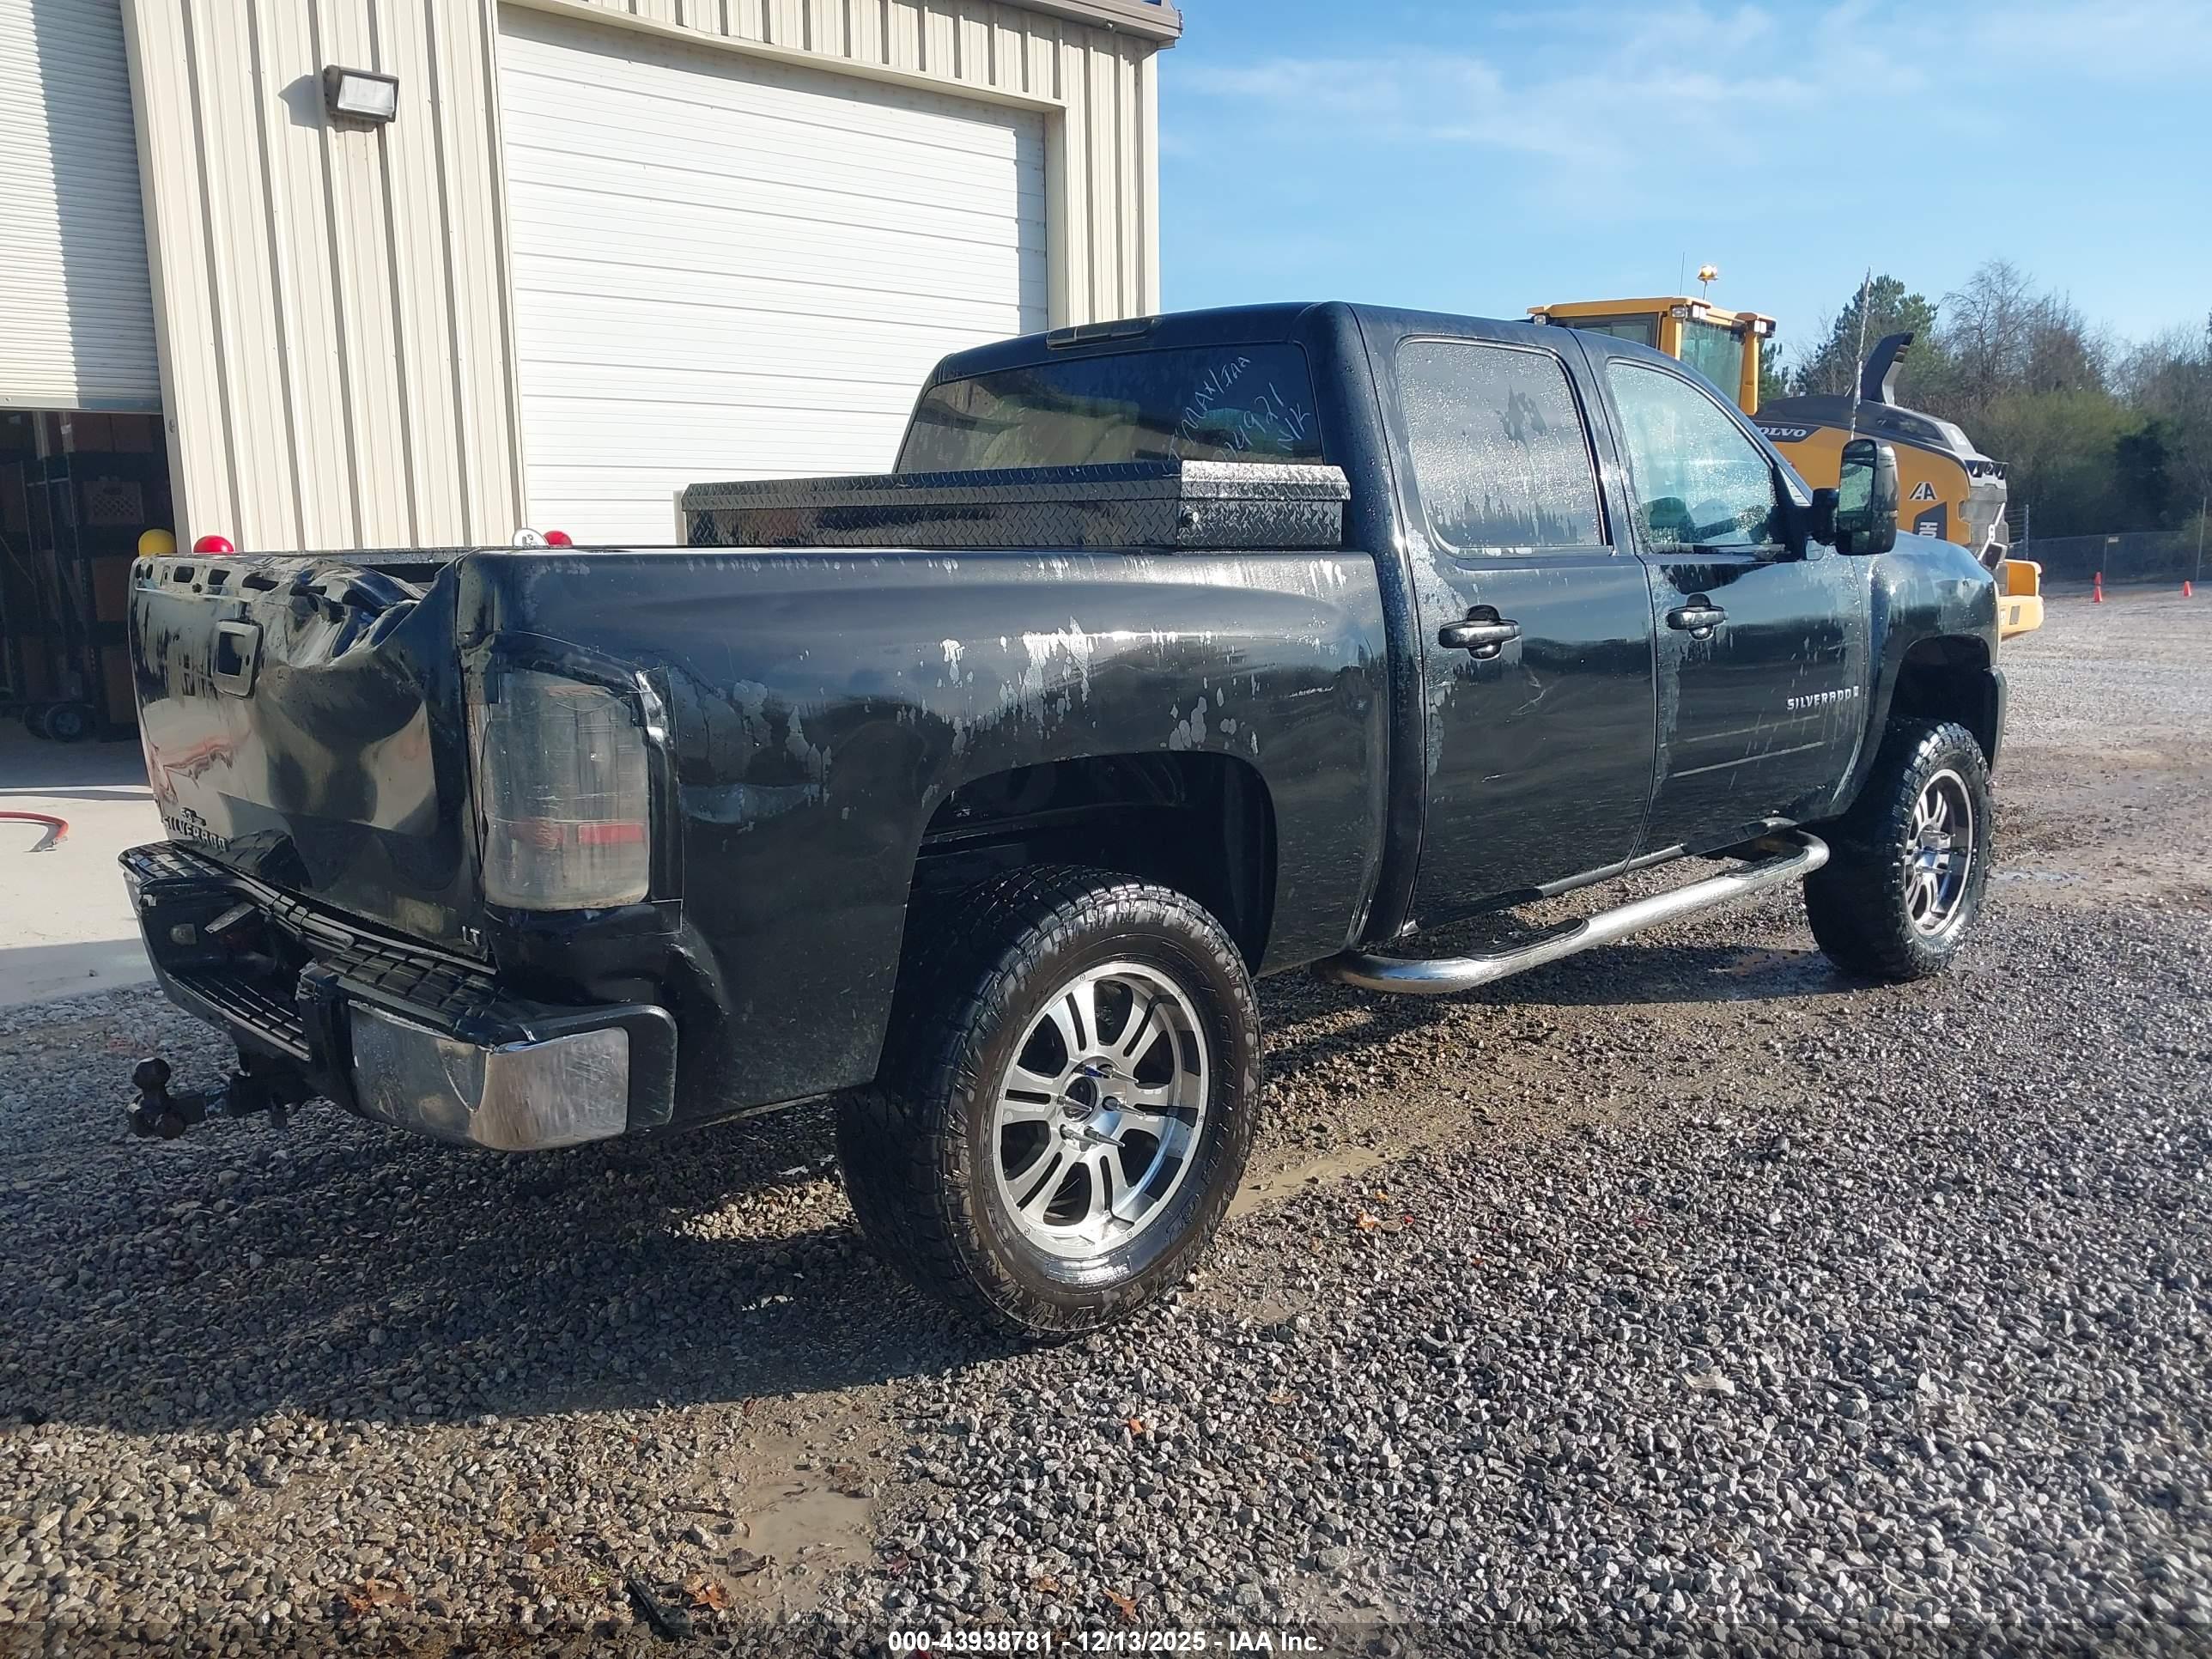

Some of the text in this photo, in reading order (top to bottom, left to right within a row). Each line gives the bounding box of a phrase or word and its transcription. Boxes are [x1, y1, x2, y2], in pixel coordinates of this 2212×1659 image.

[1759, 427, 1808, 437] OLVO
[1786, 688, 1851, 711] SILVERADO
[461, 925, 482, 947] LT
